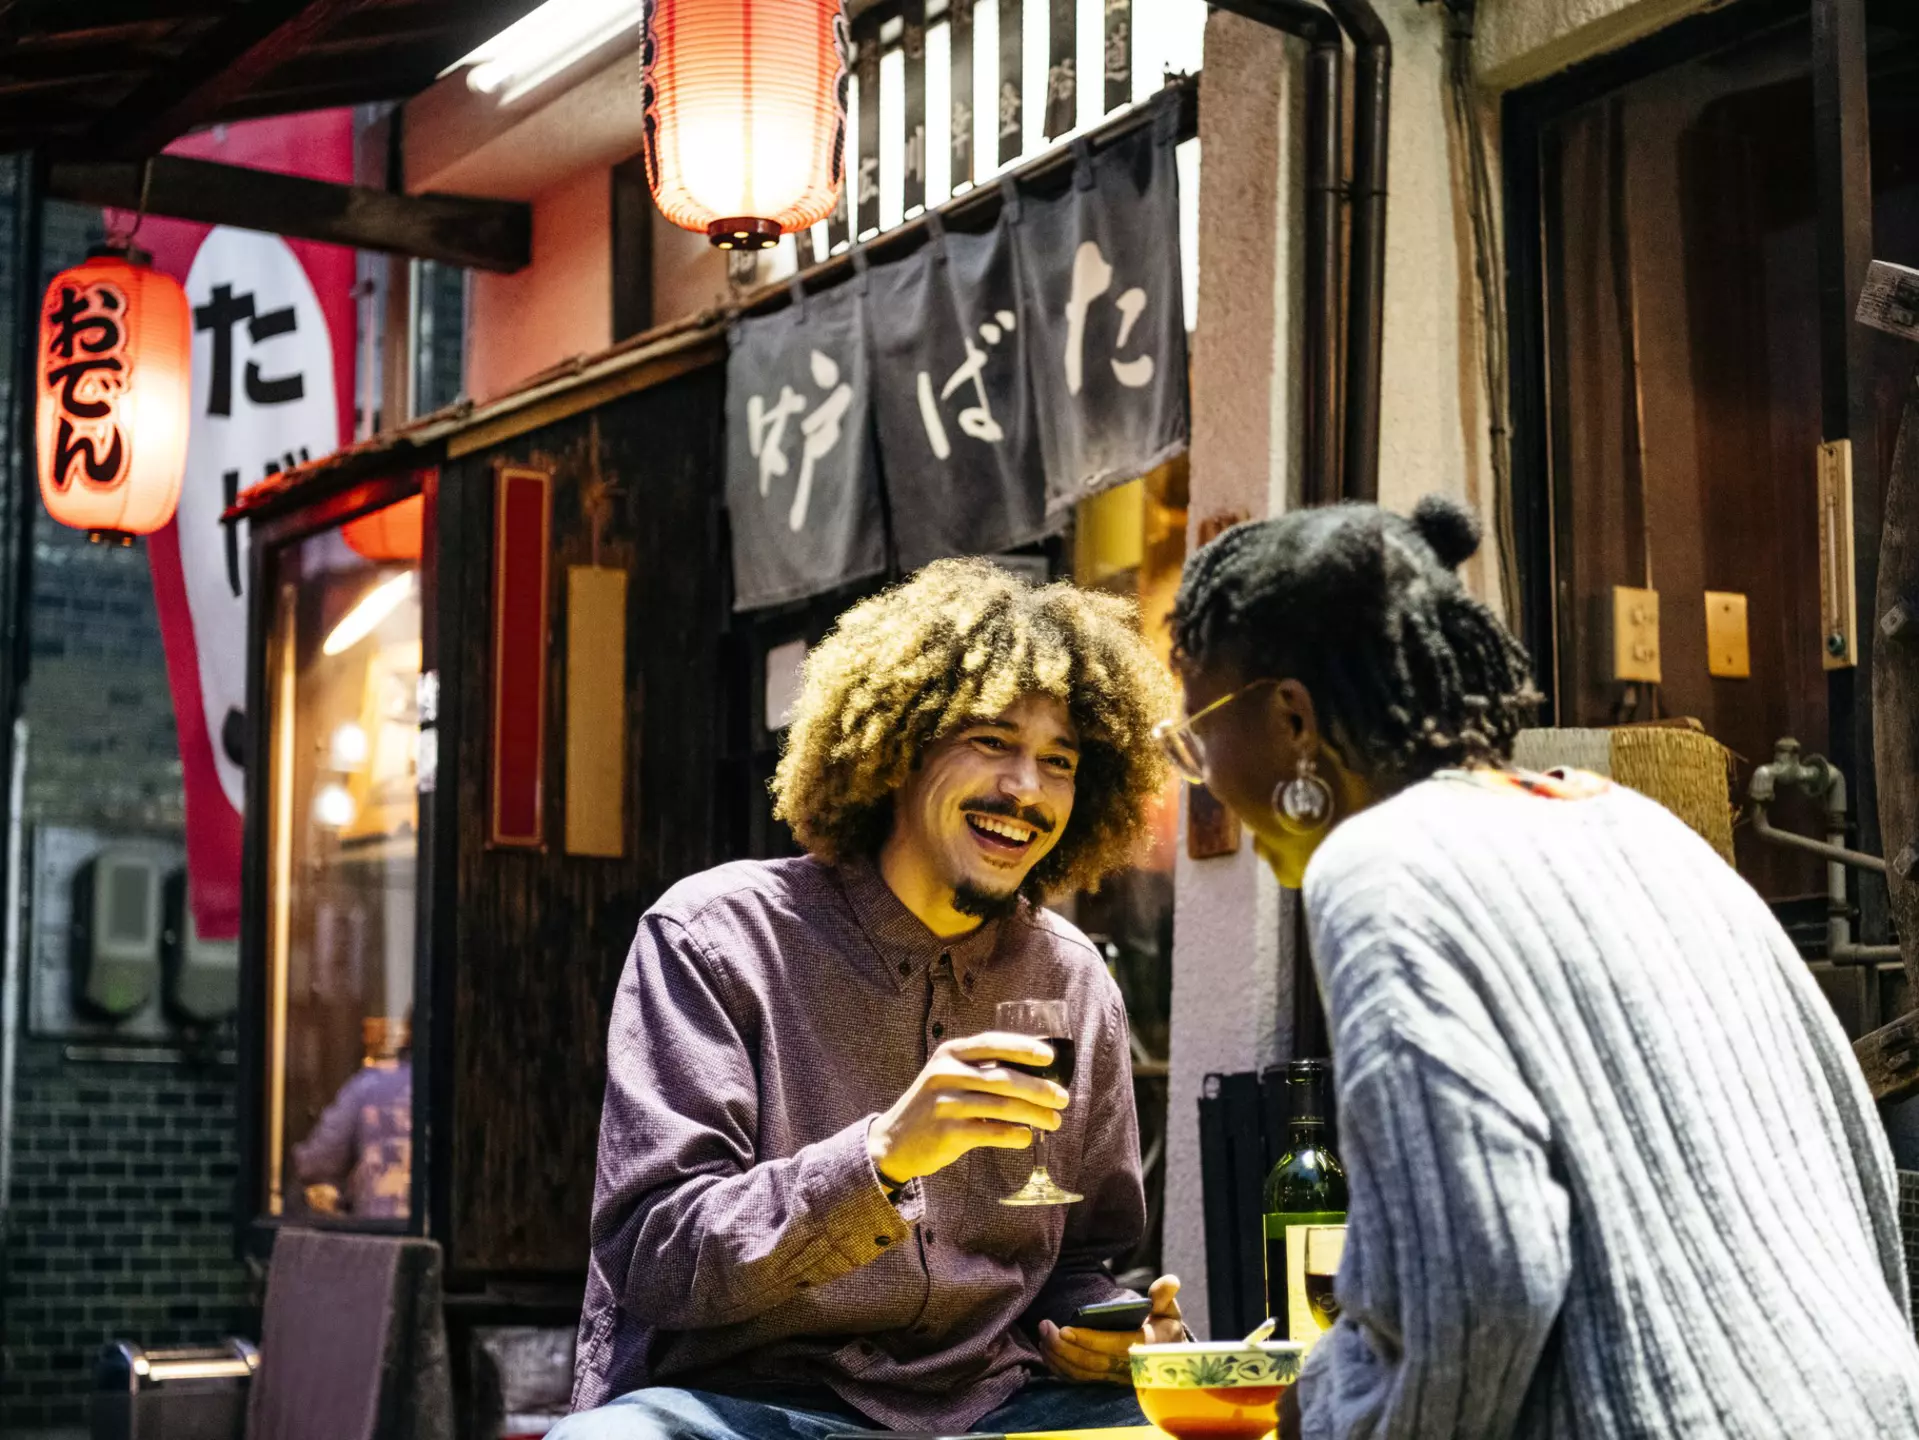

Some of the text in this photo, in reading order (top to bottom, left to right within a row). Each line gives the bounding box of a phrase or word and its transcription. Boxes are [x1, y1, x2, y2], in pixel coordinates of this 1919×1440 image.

[48, 284, 123, 485] おでん
[747, 240, 1155, 532] 炉ばた
